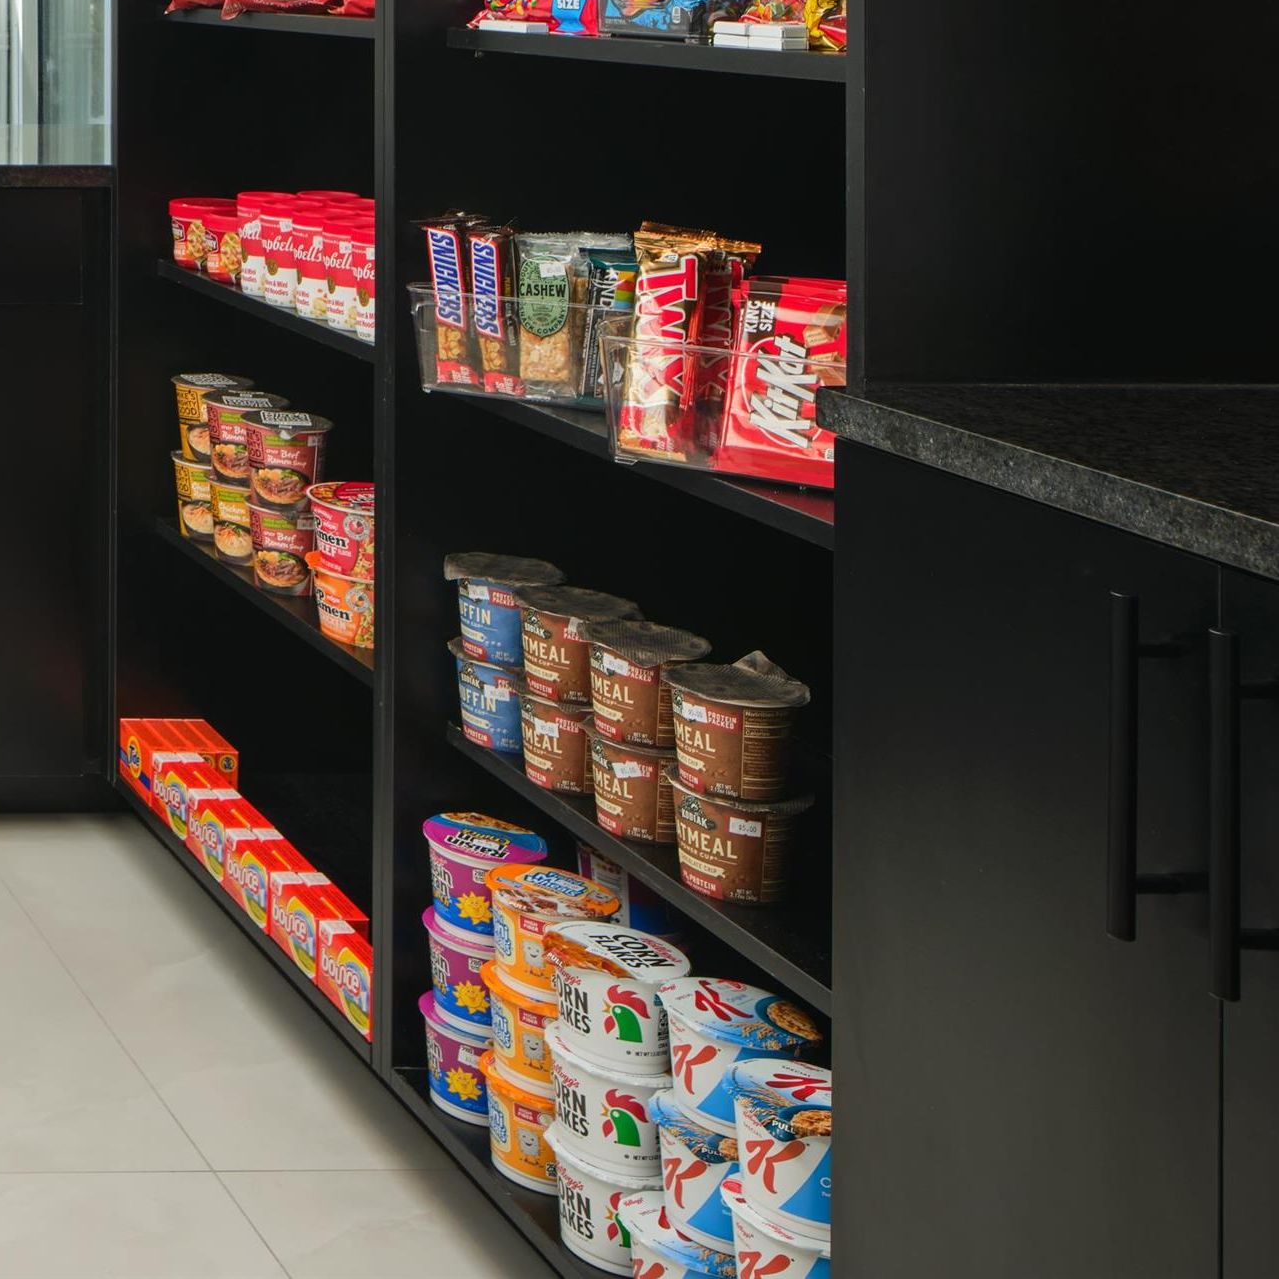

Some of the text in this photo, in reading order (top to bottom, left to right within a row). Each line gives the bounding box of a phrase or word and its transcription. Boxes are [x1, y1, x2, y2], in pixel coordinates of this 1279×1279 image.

[430, 231, 461, 325] SNICKERS
[472, 241, 500, 336] SNICKERS
[519, 283, 567, 298] CASHEW
[743, 300, 760, 333] KING
[760, 301, 776, 332] SIZE
[706, 710, 737, 723] PROTEIN
[153, 774, 181, 809] bounce
[189, 812, 218, 850] bounce
[681, 809, 708, 830] KODIAK
[226, 853, 260, 893] bounce
[272, 898, 308, 943] bounce
[546, 951, 564, 968] PULL
[588, 934, 651, 969] FLAKES
[613, 934, 675, 968] CORN
[321, 947, 361, 996] bounce
[673, 1043, 718, 1095] K
[771, 1119, 796, 1135] PULL
[663, 1157, 708, 1210] K
[745, 1138, 806, 1194] K
